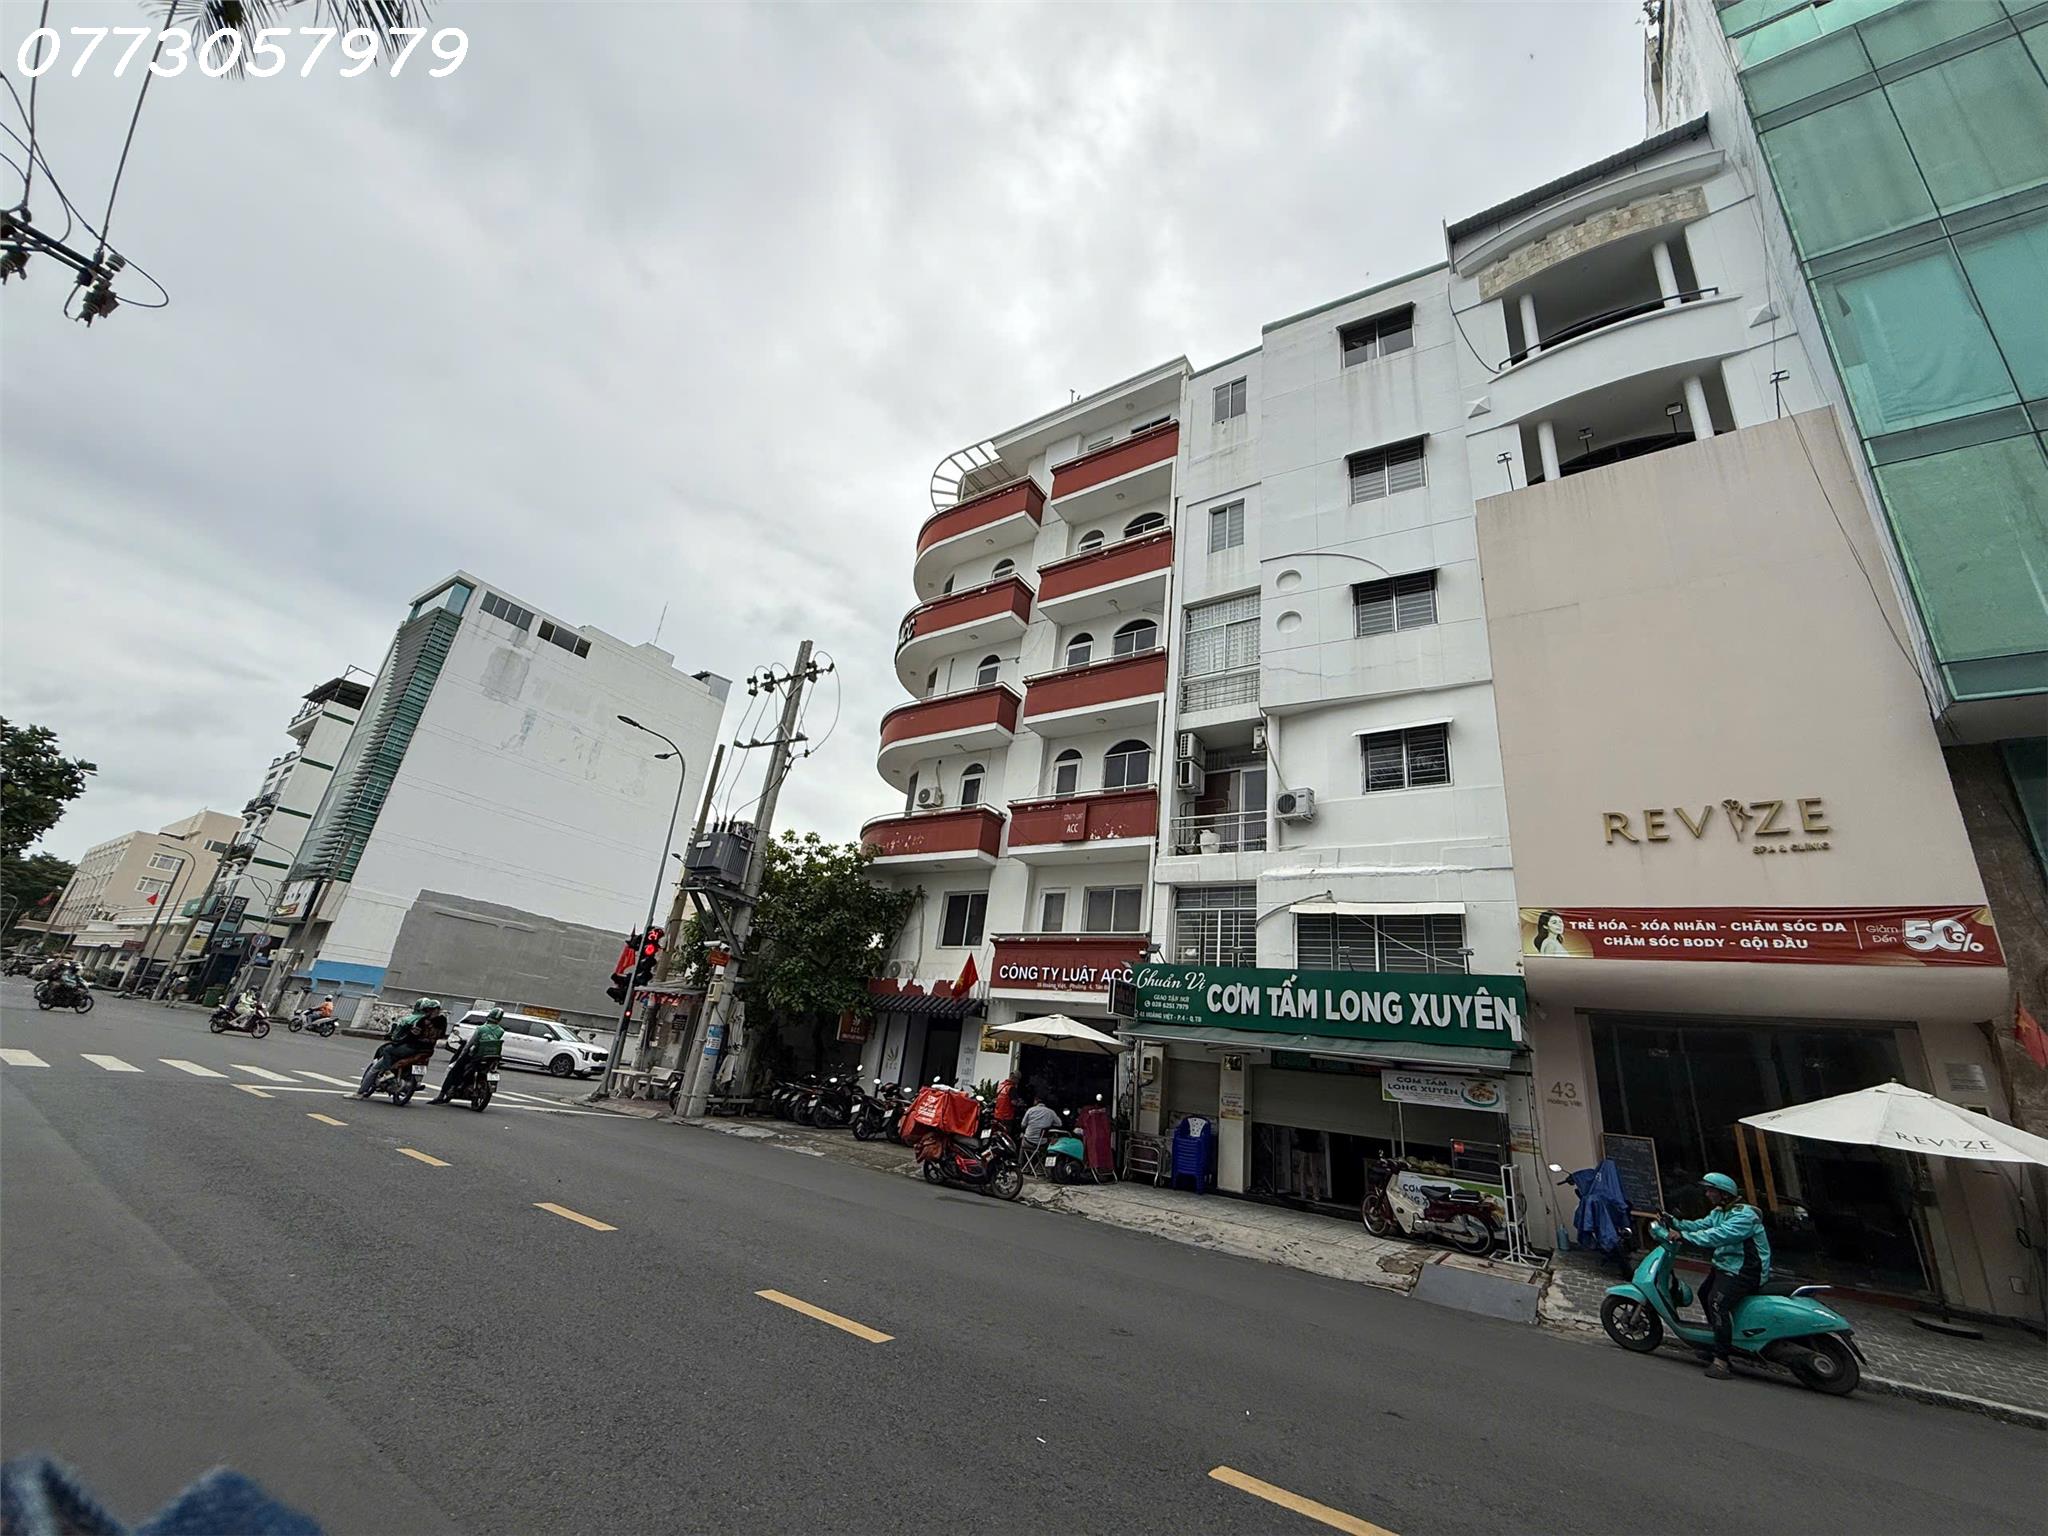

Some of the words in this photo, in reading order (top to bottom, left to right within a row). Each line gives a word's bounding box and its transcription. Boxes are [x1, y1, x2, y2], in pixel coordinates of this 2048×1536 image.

[1066, 823, 1079, 833] ACC
[1569, 917, 1595, 930] TRẺ
[1598, 918, 1628, 930] HÓA
[1641, 919, 1670, 931] XÓA
[1730, 919, 1779, 932] CHĂM
[1782, 918, 1817, 932] SÓC
[1821, 922, 1847, 932] DA
[1866, 924, 1899, 934] Giảm
[1603, 934, 1645, 946] CHĂM
[1649, 934, 1681, 947] SÓC
[1684, 938, 1725, 948] BODY
[1740, 936, 1768, 950] GỘI
[1773, 933, 1809, 949] ĐẦU
[1872, 934, 1897, 944] Đến
[1902, 917, 1984, 952] 50%
[1000, 962, 1038, 980] CÔNG
[1042, 966, 1060, 981] TY
[1062, 964, 1098, 984] LUẬT
[1101, 968, 1134, 983] ACC
[1136, 968, 1182, 989] Chuẩn
[1184, 971, 1206, 992] Vị
[1207, 982, 1260, 1015] CƠM
[1266, 974, 1318, 1019] TẤM
[1325, 989, 1403, 1024] LONG
[1409, 987, 1522, 1042] XUYÊN
[1388, 1083, 1418, 1092] LONG
[1420, 1084, 1458, 1095] XUYÊN
[1426, 1076, 1449, 1087] TẤM
[1551, 1081, 1577, 1099] 43
